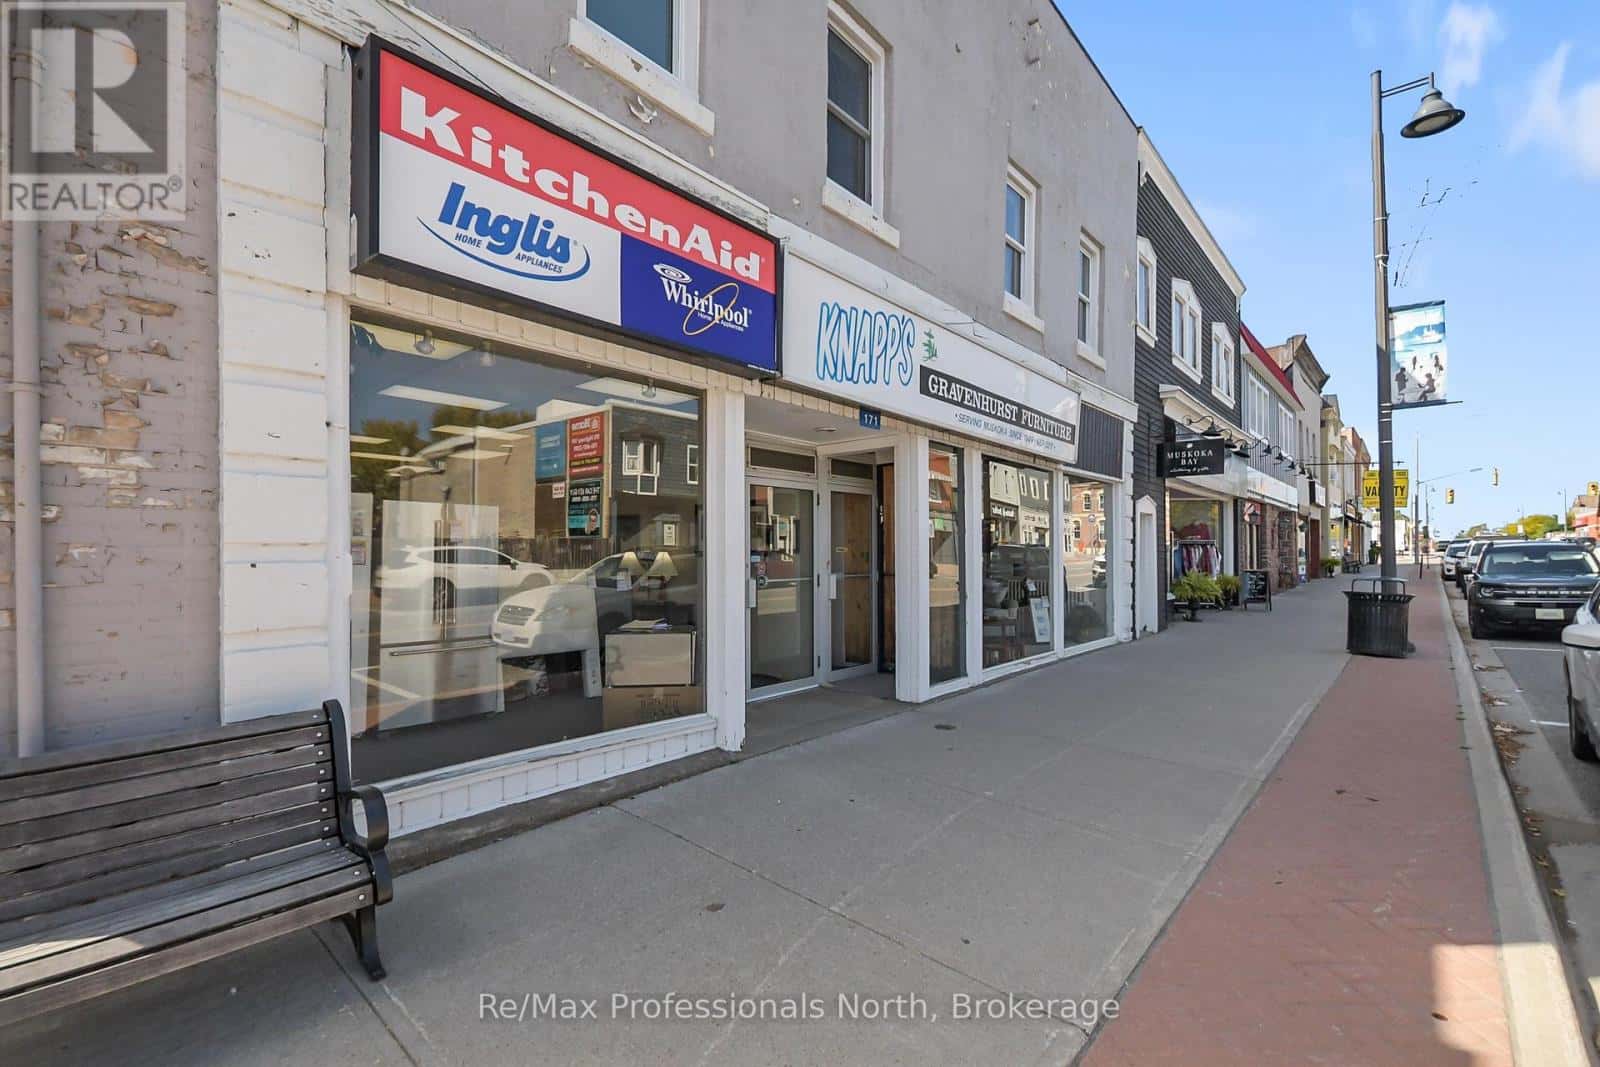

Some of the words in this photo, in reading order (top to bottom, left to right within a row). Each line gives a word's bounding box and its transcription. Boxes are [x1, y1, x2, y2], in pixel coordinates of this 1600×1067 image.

[400, 86, 761, 281] KitchenAid
[438, 181, 571, 264] Inglis
[454, 232, 483, 248] HOME
[515, 252, 563, 273] APPLIANCES
[660, 276, 749, 328] Whirlpool
[816, 301, 916, 387] KNAPP'S
[863, 413, 878, 426] 171
[927, 373, 1019, 423] GRAVENHURST
[1021, 409, 1072, 442] FURNITURE
[1167, 449, 1213, 459] MUSKOKA
[1365, 485, 1405, 496] VATY
